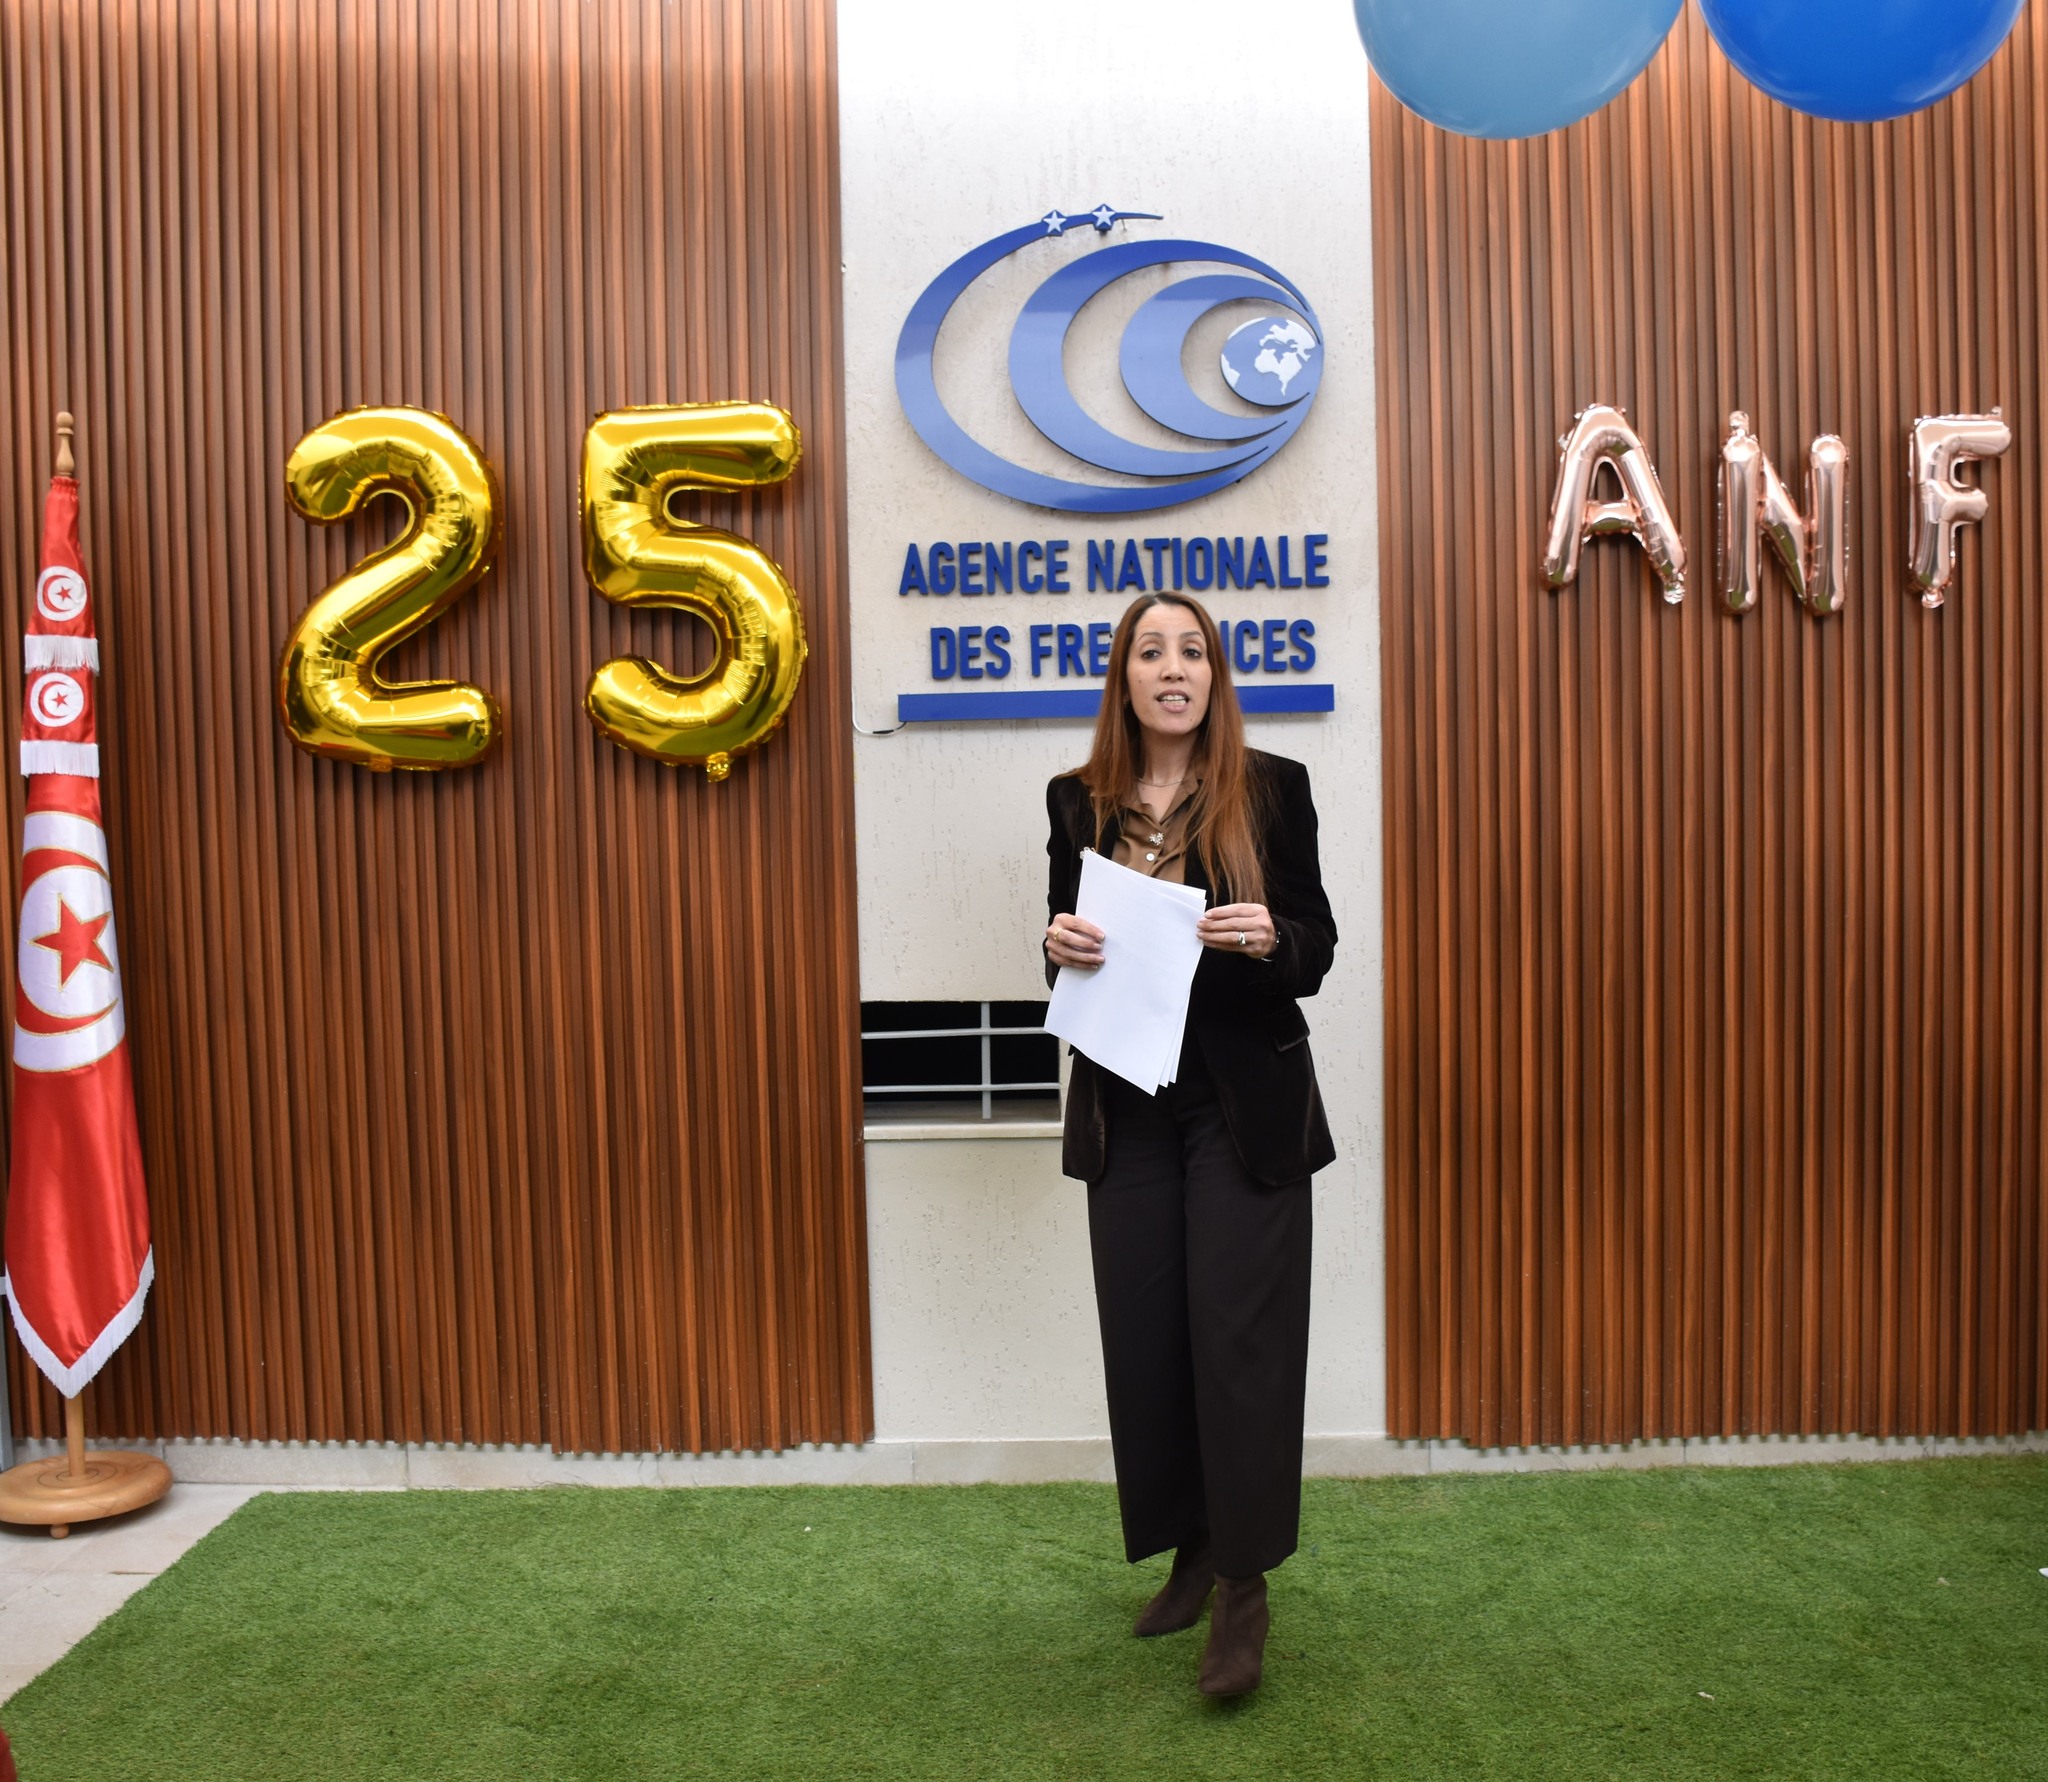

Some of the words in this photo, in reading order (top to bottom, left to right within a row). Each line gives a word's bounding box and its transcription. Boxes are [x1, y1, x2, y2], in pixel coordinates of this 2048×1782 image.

[900, 540, 1070, 596] AGENCE
[1087, 534, 1330, 592] NATIONALE
[1542, 401, 2012, 617] ANF
[281, 402, 808, 782] 25
[930, 625, 1012, 680] DES
[1029, 619, 1317, 677] FRECES
